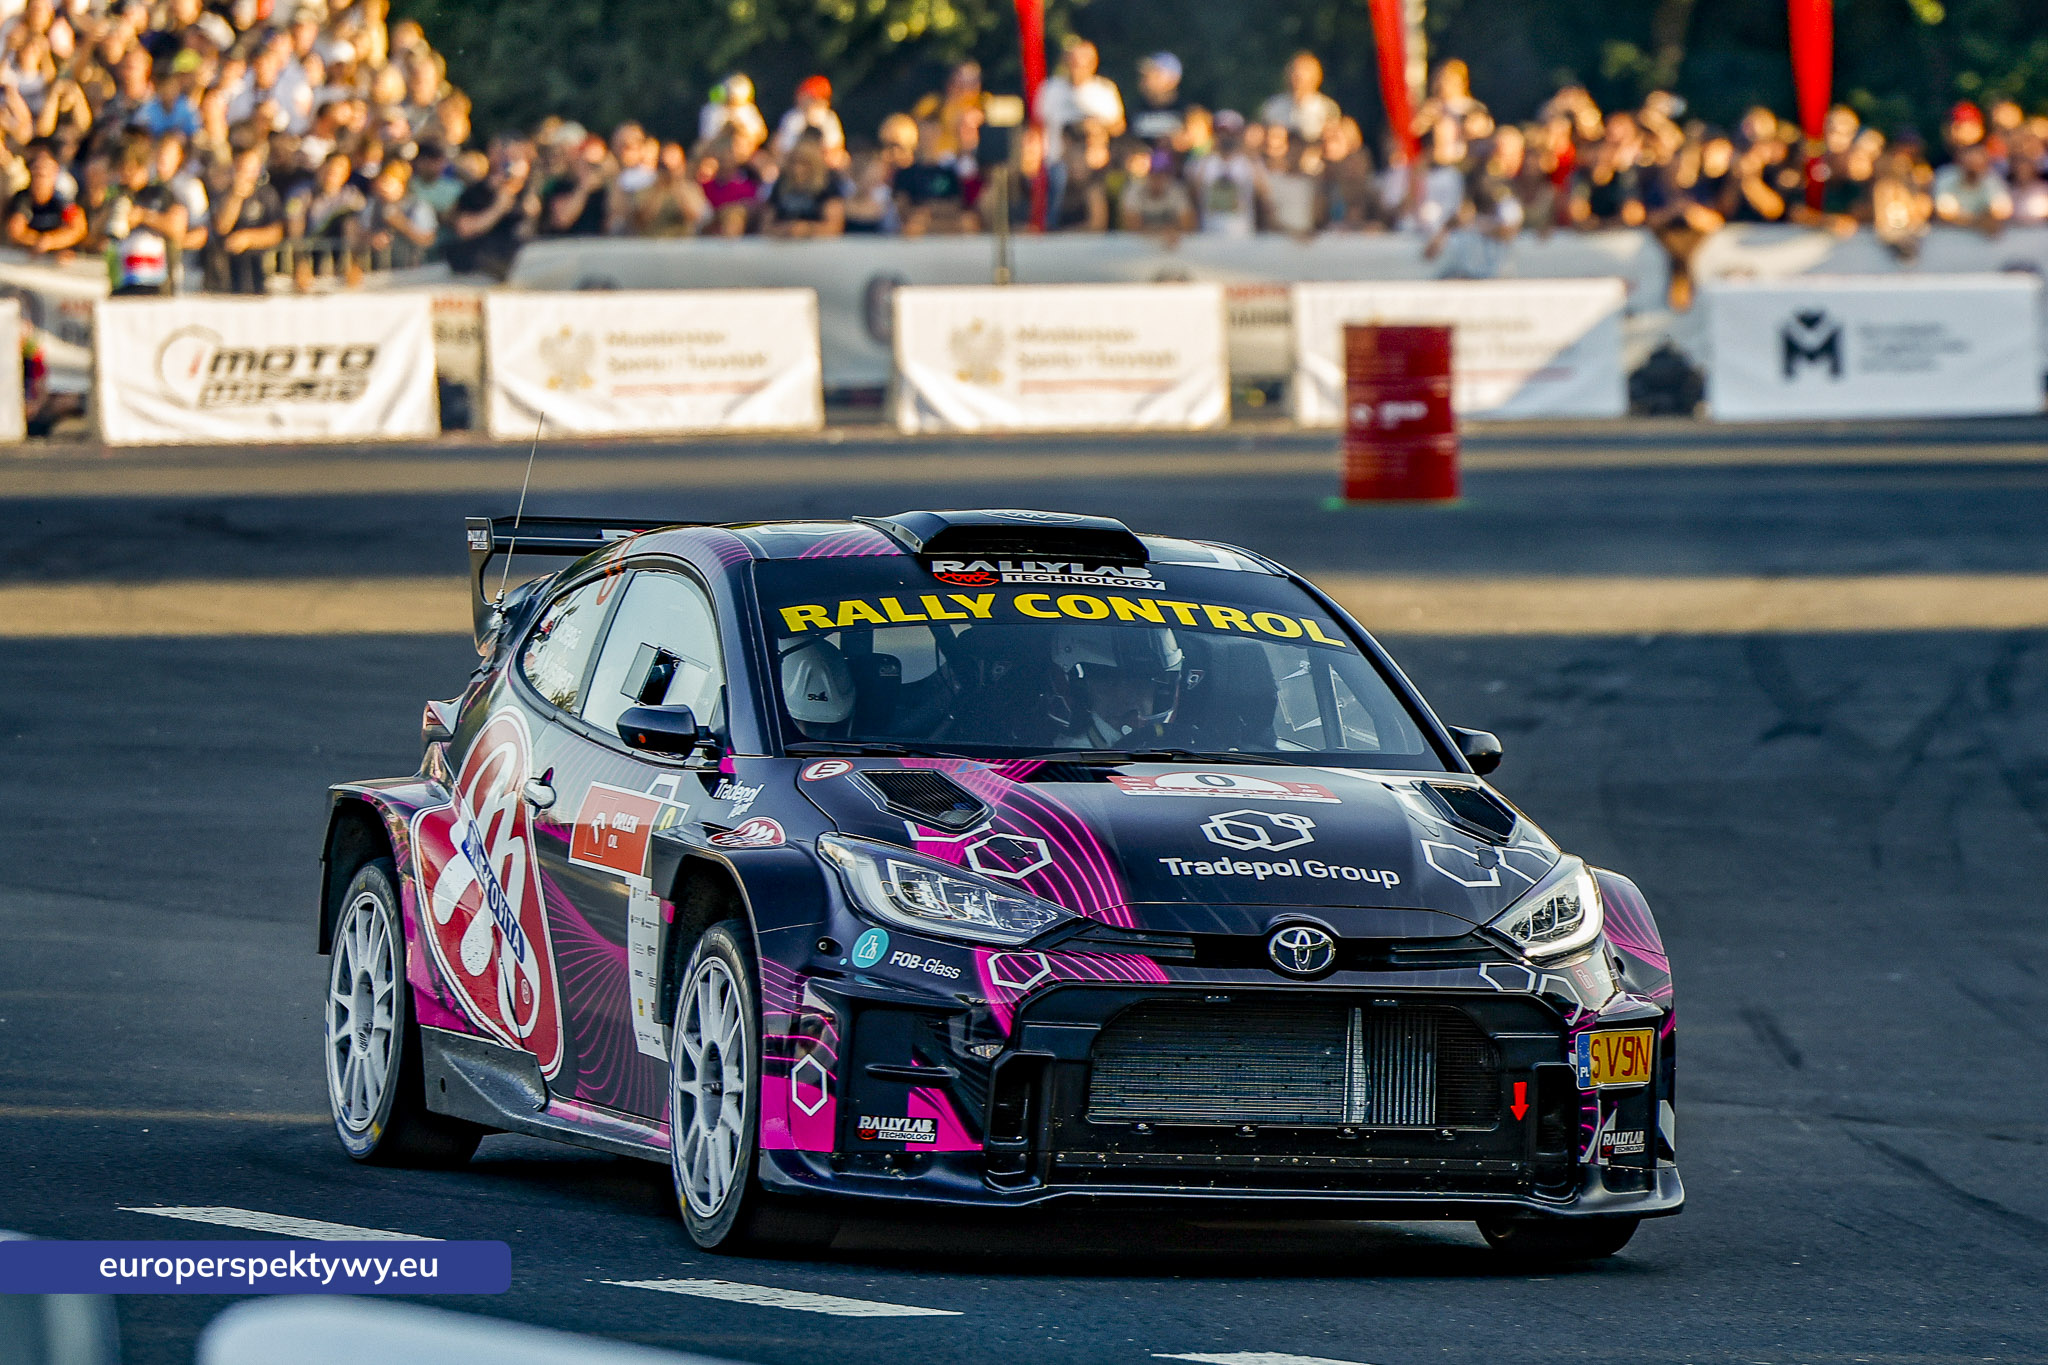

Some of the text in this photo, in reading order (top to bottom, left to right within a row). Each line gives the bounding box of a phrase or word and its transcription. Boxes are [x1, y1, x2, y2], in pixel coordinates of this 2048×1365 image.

[931, 560, 1152, 579] RALLYLAB
[1006, 573, 1162, 589] TECHNOLOGY
[779, 593, 1347, 648] RALLY CONTROL
[1195, 774, 1236, 787] 0
[889, 950, 961, 979] FOB-Glass
[1580, 1066, 1590, 1078] PL
[858, 1115, 934, 1133] RALLYLAB
[880, 1131, 934, 1141] TECHNOLOGY
[1602, 1130, 1645, 1146] RALLYLAB
